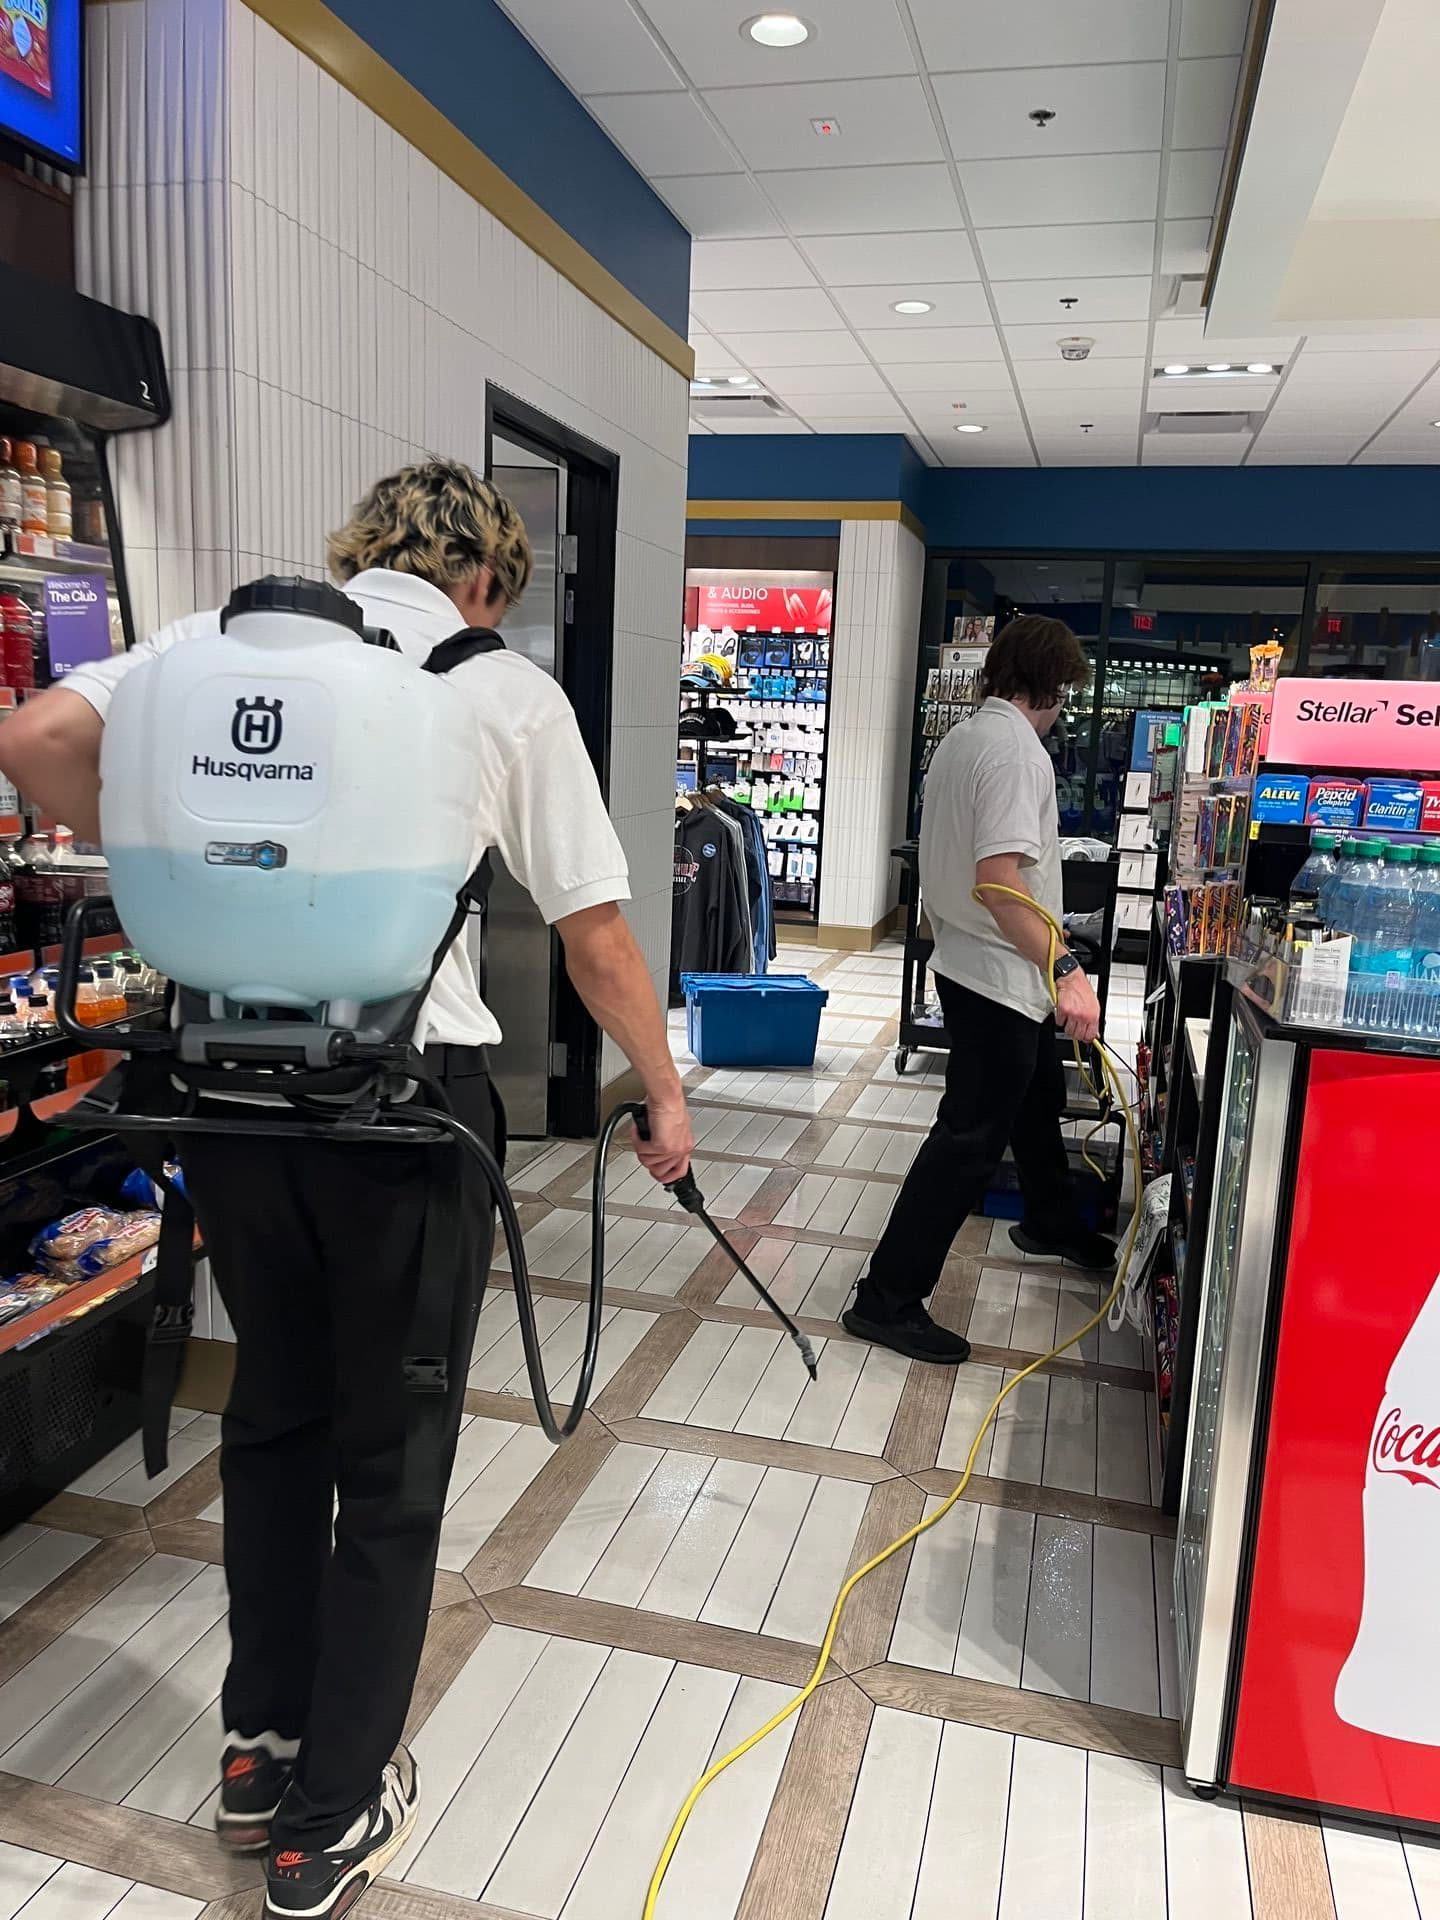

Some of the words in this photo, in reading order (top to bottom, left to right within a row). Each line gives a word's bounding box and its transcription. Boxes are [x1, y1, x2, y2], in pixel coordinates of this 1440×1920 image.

[48, 590, 70, 602] The
[71, 590, 98, 602] Club
[707, 586, 717, 599] &
[721, 586, 768, 601] AUDIO
[1296, 700, 1378, 724] Stellar
[192, 755, 314, 782] Husqvarna
[1259, 787, 1301, 801] ALEVE
[1315, 787, 1358, 801] Pepcid
[1317, 797, 1351, 807] Complete
[1368, 802, 1407, 817] Claritin
